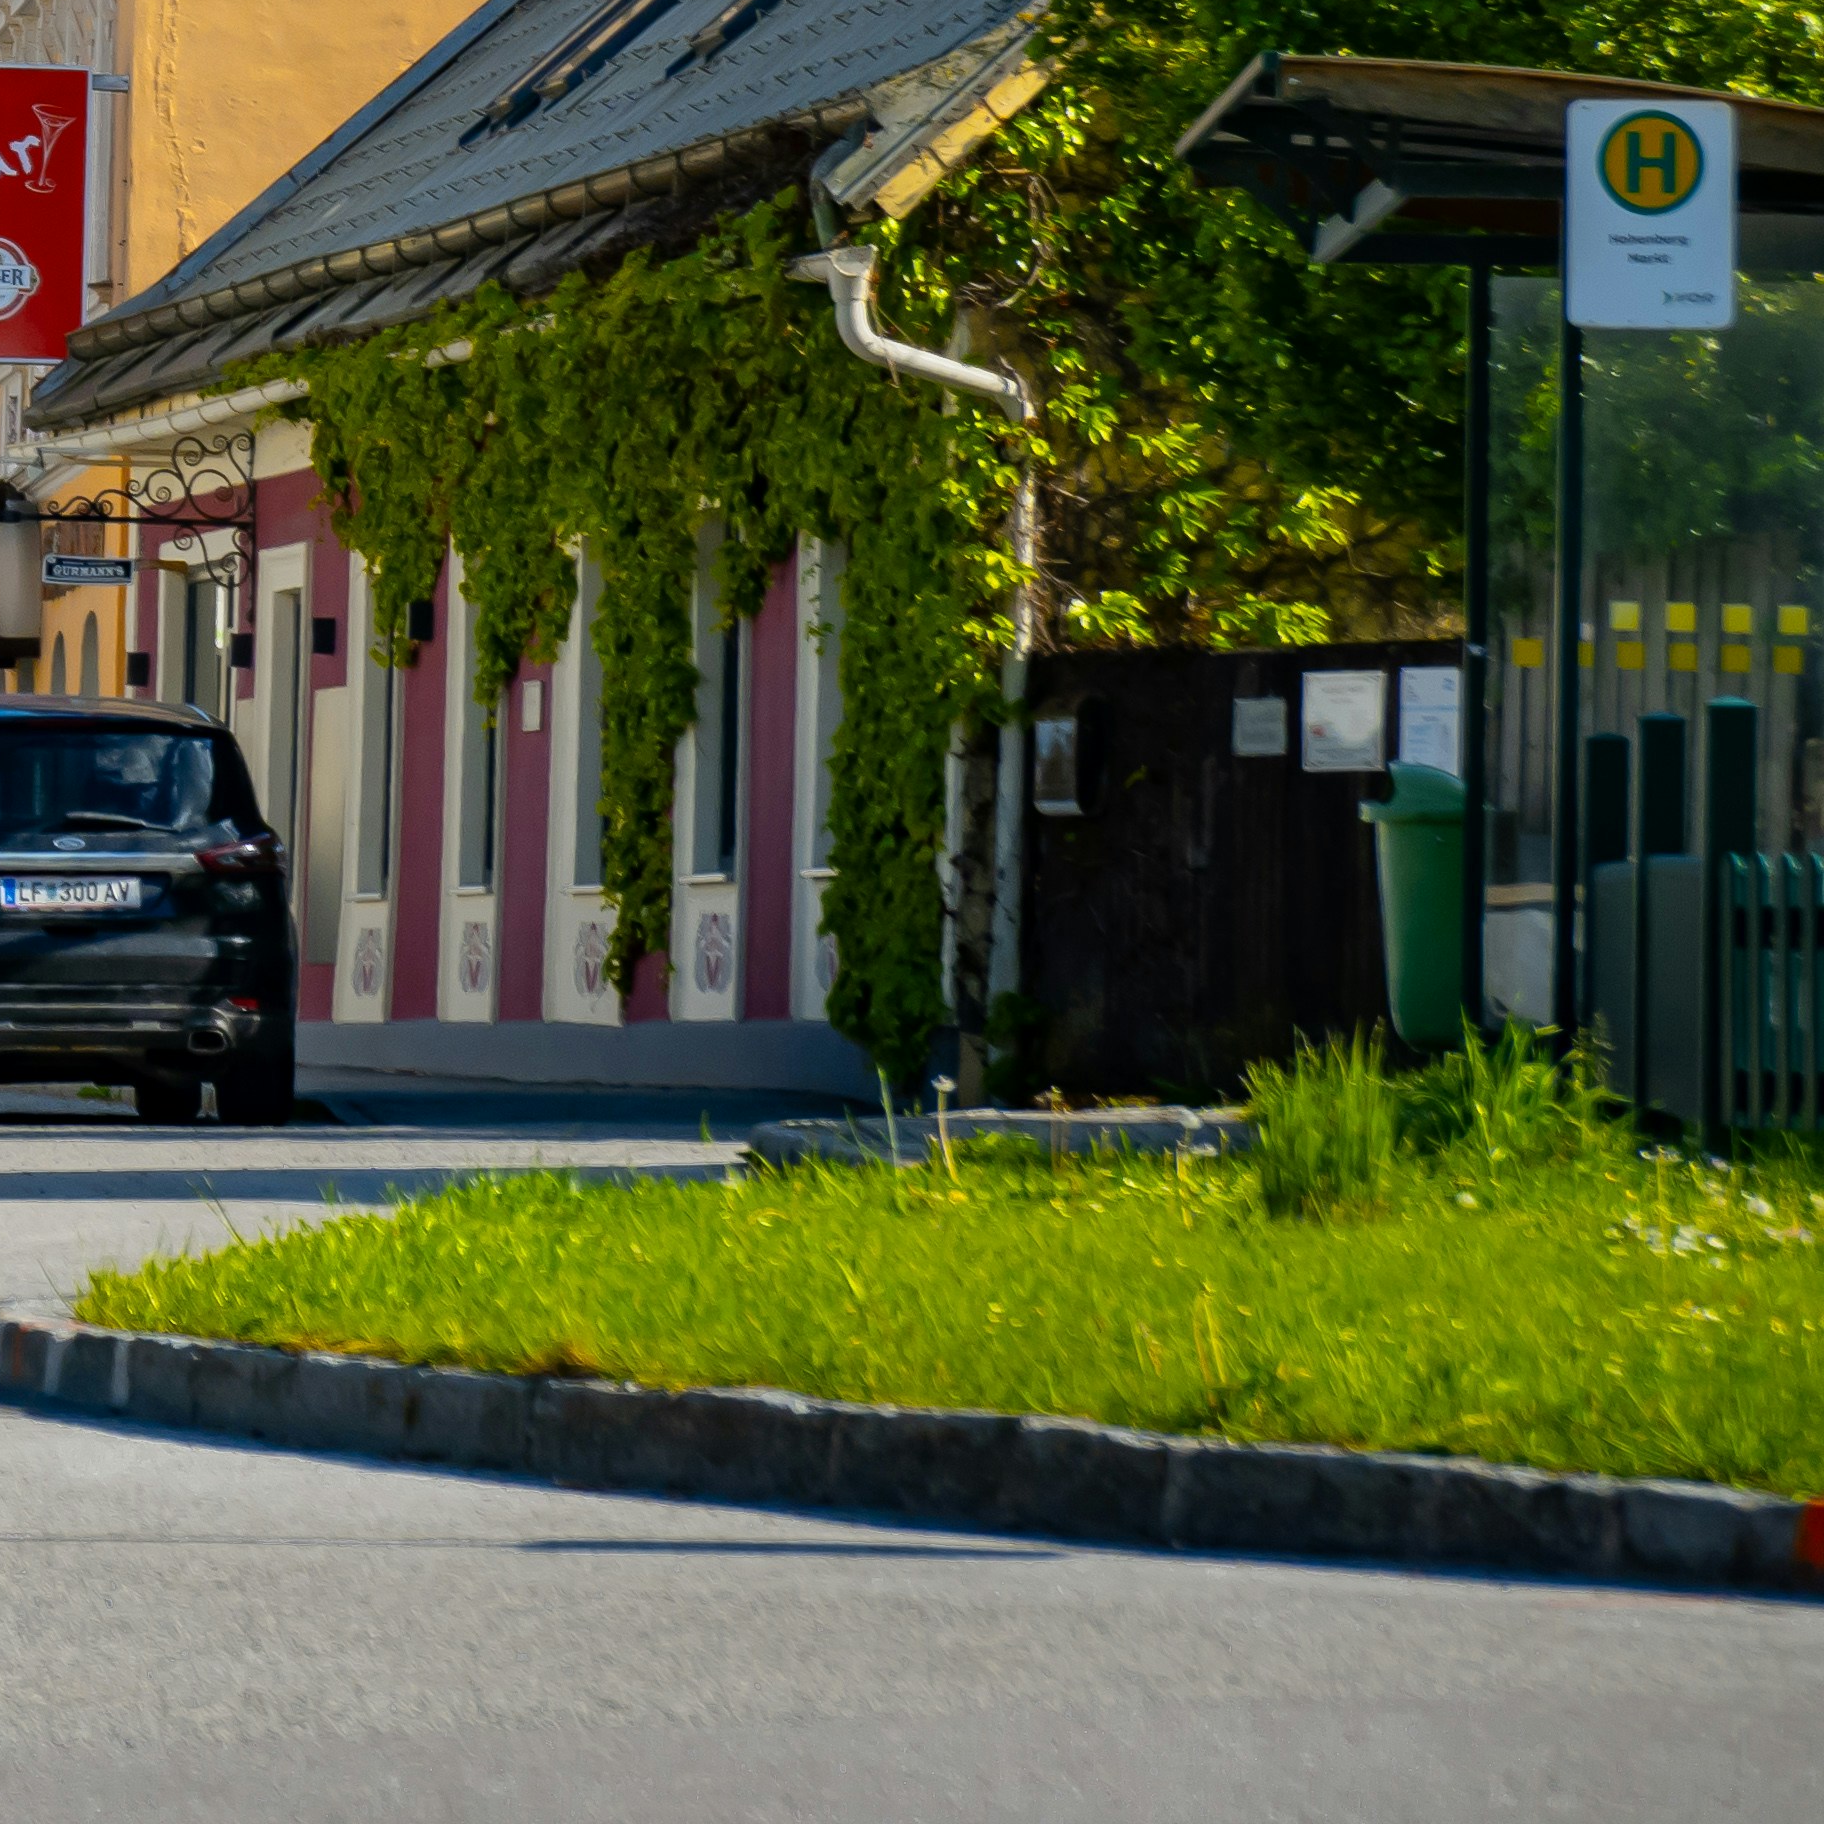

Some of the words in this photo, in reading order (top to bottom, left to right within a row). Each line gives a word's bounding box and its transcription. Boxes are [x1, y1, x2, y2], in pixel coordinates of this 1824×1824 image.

[1627, 131, 1676, 194] H
[18, 881, 43, 902] LF
[60, 882, 98, 902] 300
[104, 881, 129, 902] AV
